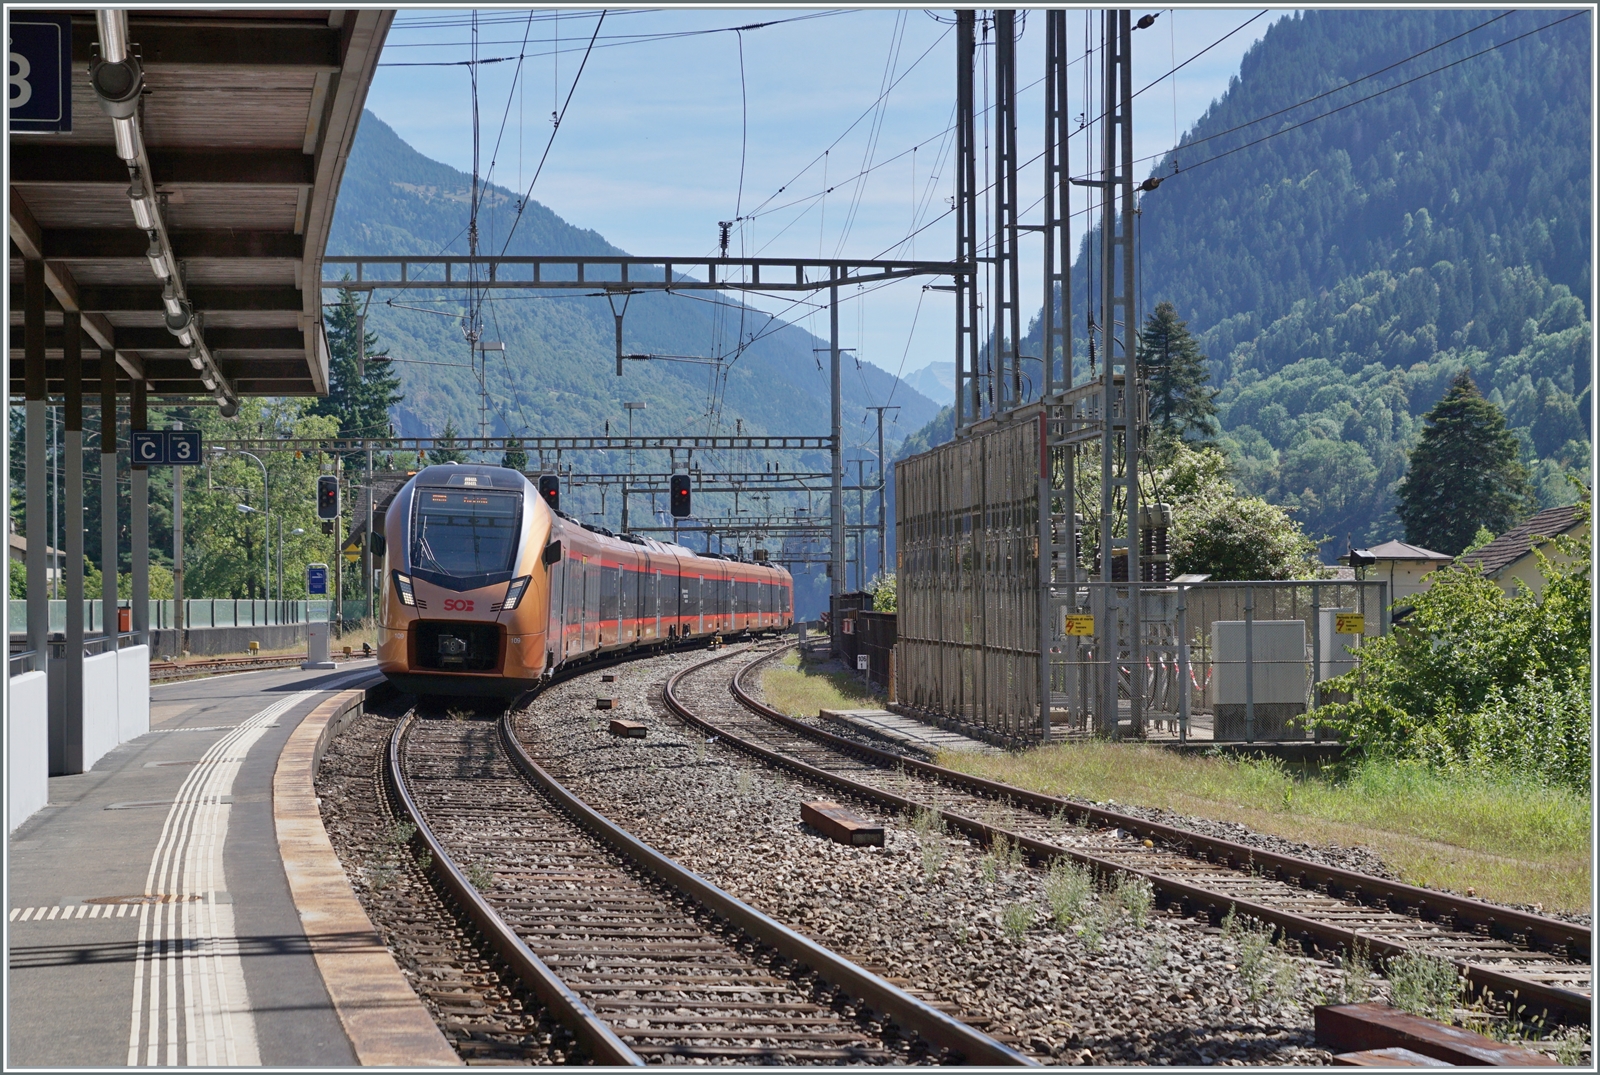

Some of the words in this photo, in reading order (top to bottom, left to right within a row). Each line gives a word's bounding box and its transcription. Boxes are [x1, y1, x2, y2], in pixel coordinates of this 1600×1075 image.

[141, 441, 156, 459] C
[177, 441, 191, 459] 3
[444, 599, 475, 611] SOB
